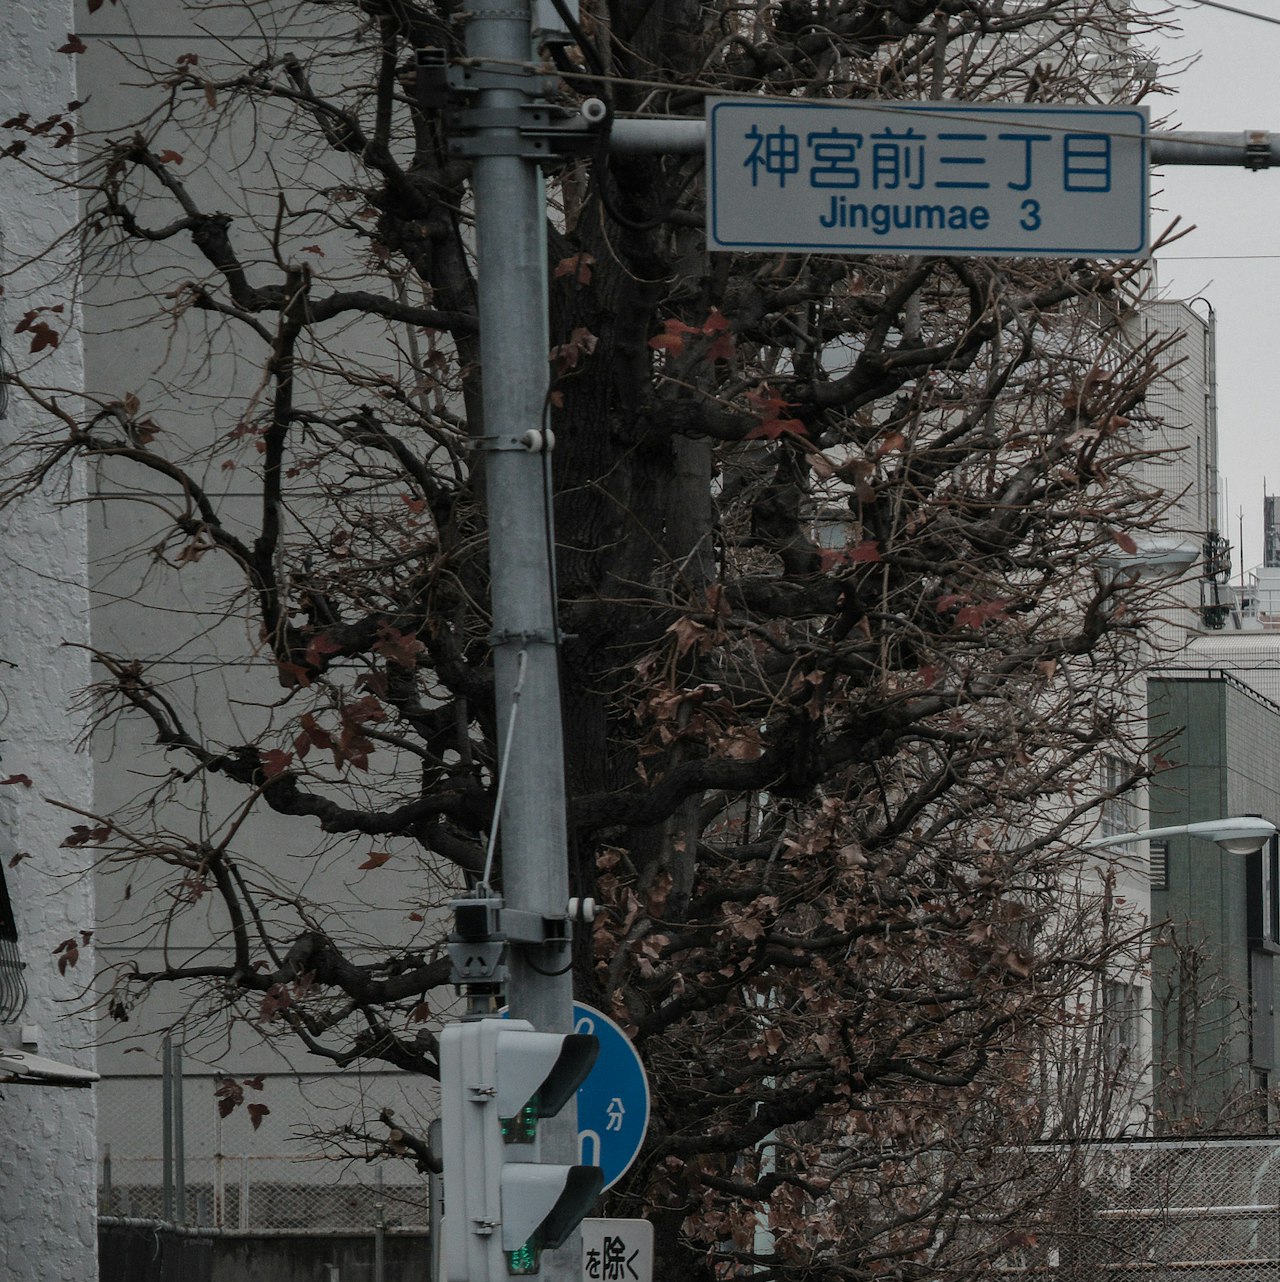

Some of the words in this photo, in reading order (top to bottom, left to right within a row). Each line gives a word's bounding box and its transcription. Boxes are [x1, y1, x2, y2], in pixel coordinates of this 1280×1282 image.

[743, 125, 1113, 192] 神宮前三丁目
[819, 195, 990, 235] Jingumae
[1019, 198, 1042, 232] 3
[605, 1097, 626, 1132] 分
[585, 1235, 640, 1282] を除く
